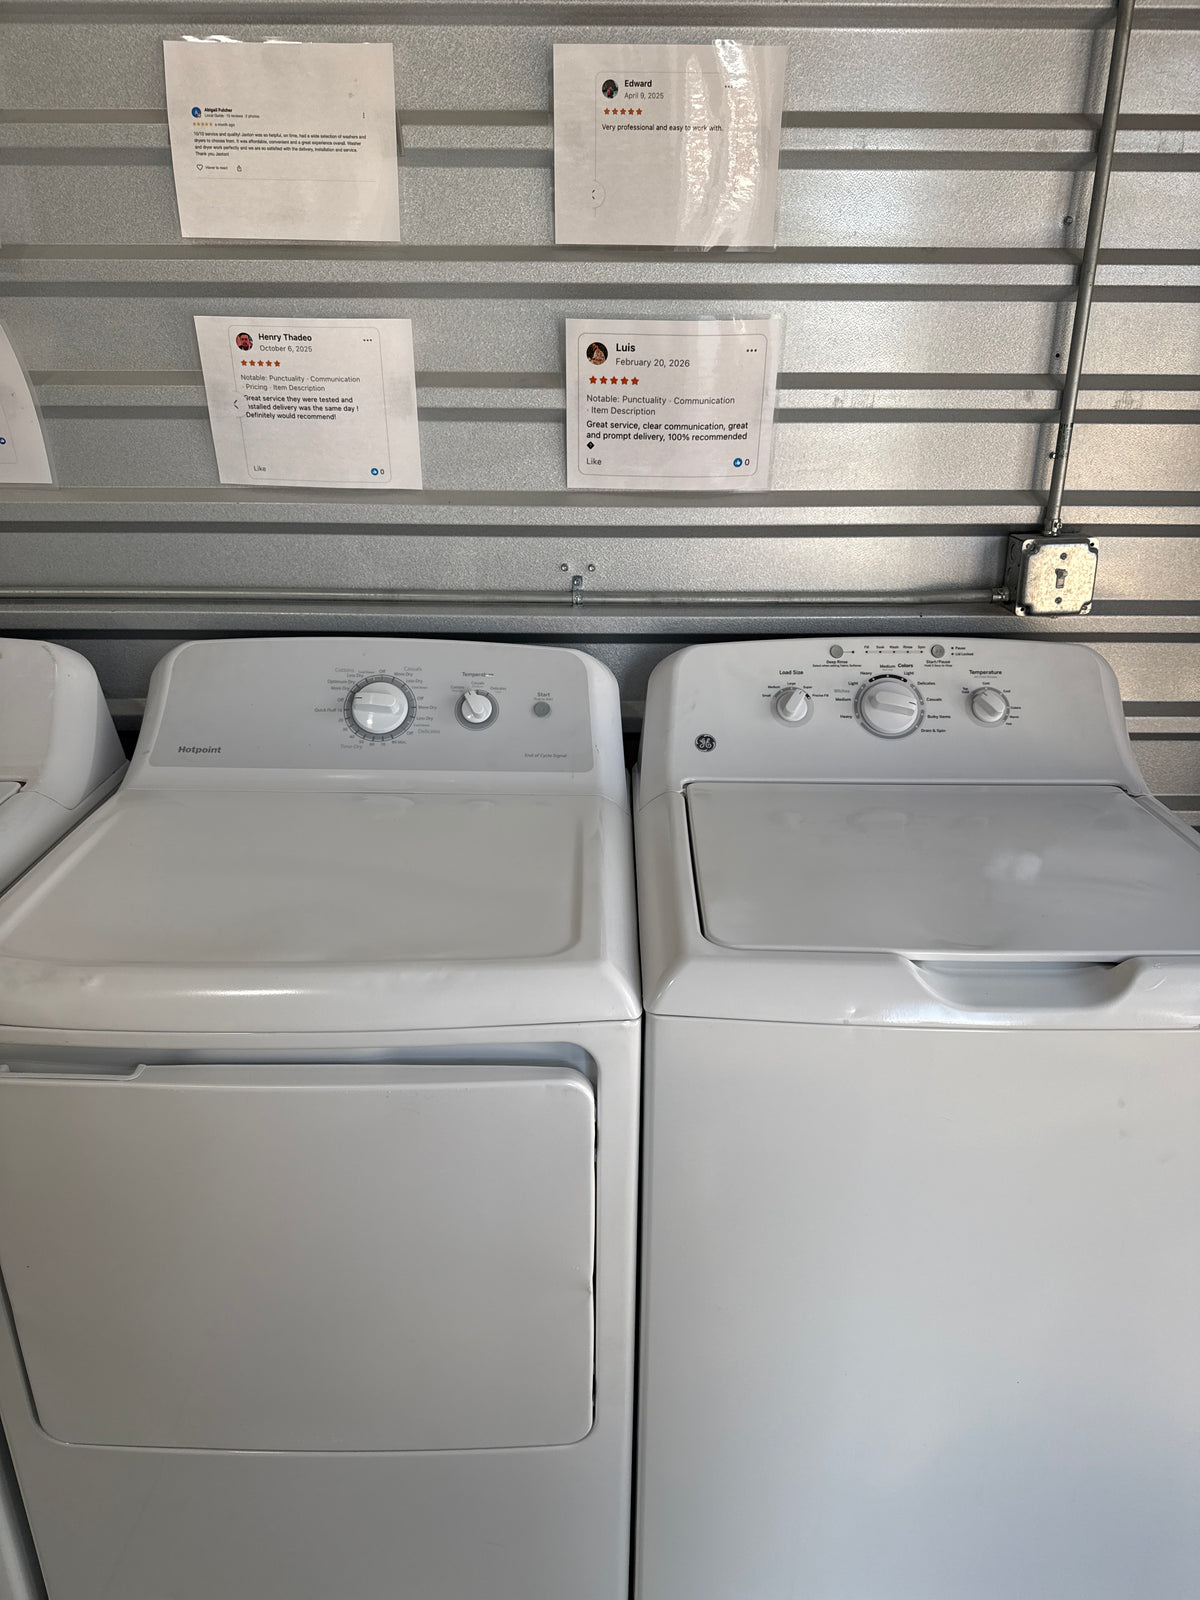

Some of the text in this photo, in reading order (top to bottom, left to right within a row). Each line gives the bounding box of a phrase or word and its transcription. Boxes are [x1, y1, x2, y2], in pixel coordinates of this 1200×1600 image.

[258, 334, 281, 342] Henry
[616, 343, 636, 352] Luis
[616, 358, 651, 367] February
[654, 359, 666, 368] 20,
[622, 396, 666, 405] Punctuality
[611, 408, 656, 416] Description
[664, 422, 726, 431] communication,
[728, 422, 748, 431] great
[633, 433, 666, 442] delivery,
[692, 432, 747, 441] recommended
[178, 746, 221, 754] Hotpoint
